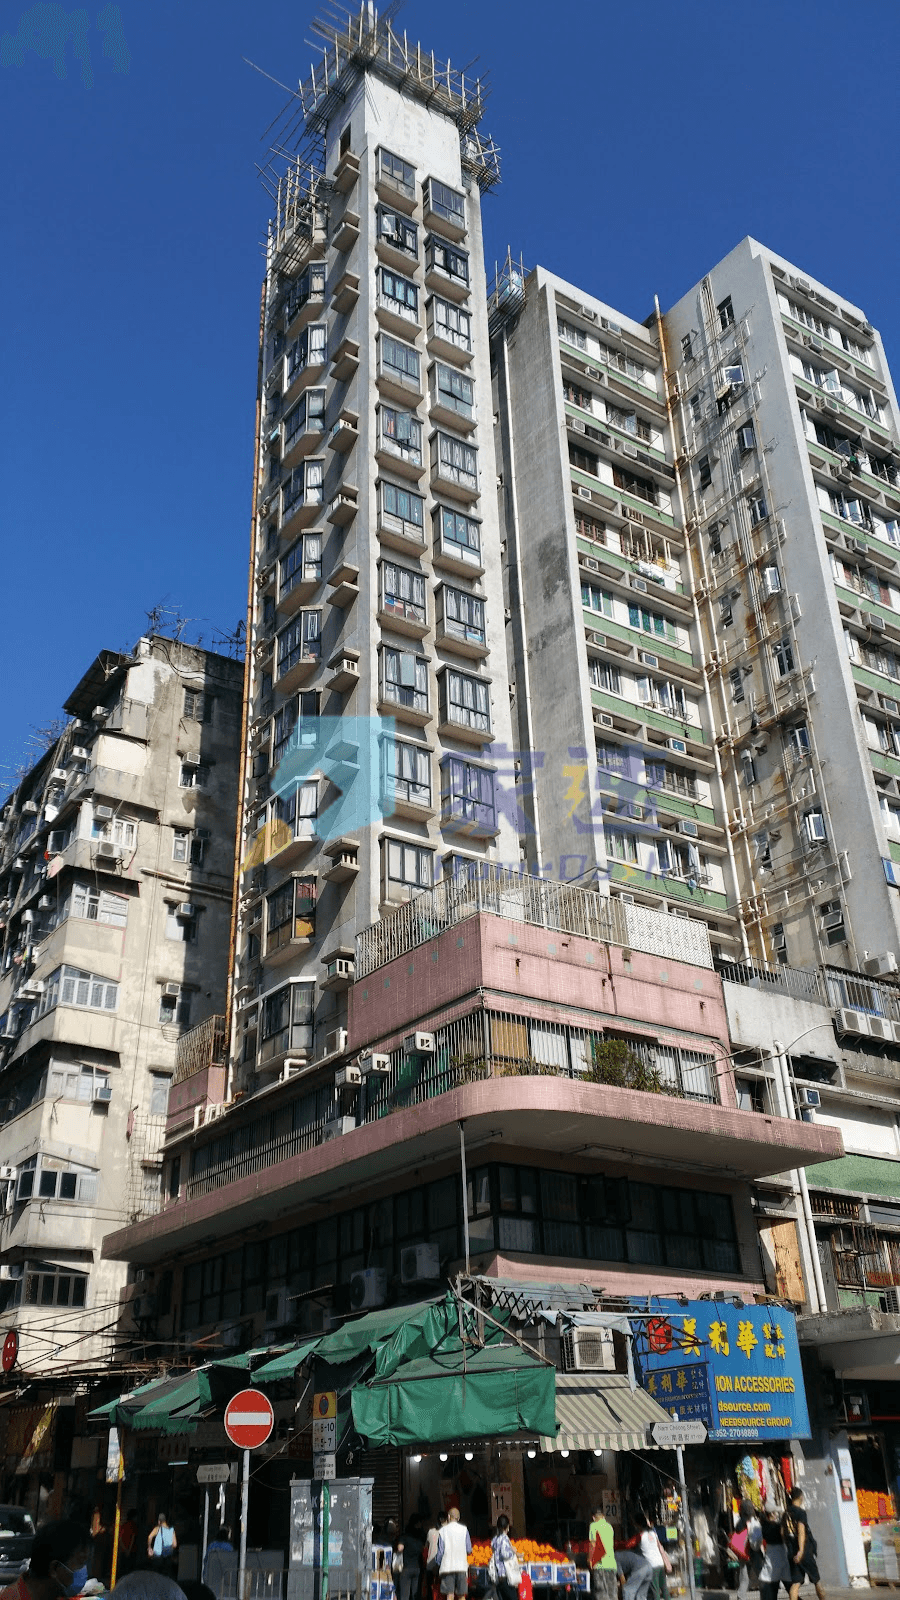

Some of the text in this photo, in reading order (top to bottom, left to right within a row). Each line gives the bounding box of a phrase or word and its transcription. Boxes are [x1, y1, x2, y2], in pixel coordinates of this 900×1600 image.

[715, 1375, 796, 1393] ION ACCESSORIES
[605, 1504, 617, 1517] 20
